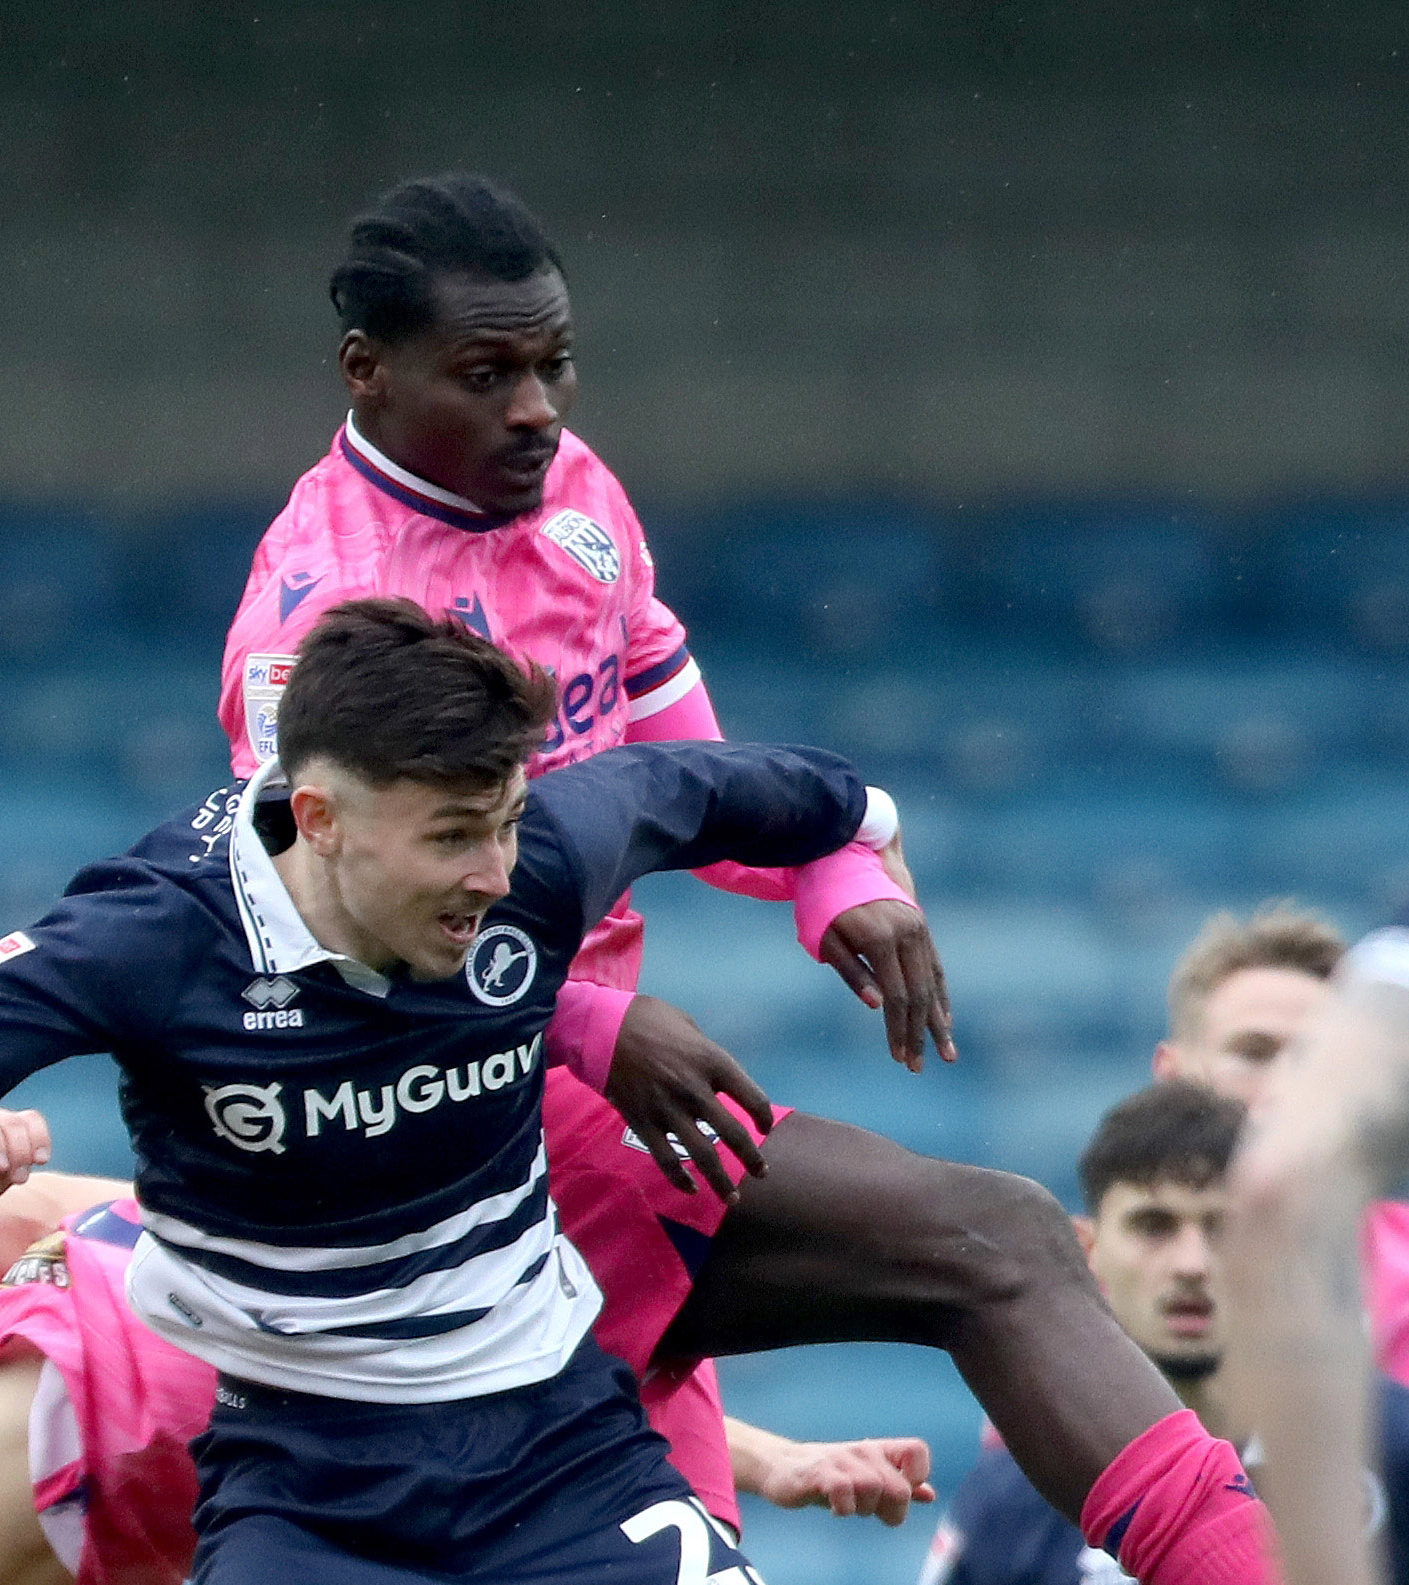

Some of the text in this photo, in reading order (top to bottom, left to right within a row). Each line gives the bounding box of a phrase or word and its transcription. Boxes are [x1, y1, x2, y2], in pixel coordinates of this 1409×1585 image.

[248, 665, 292, 684] sky be
[243, 1008, 303, 1030] errea
